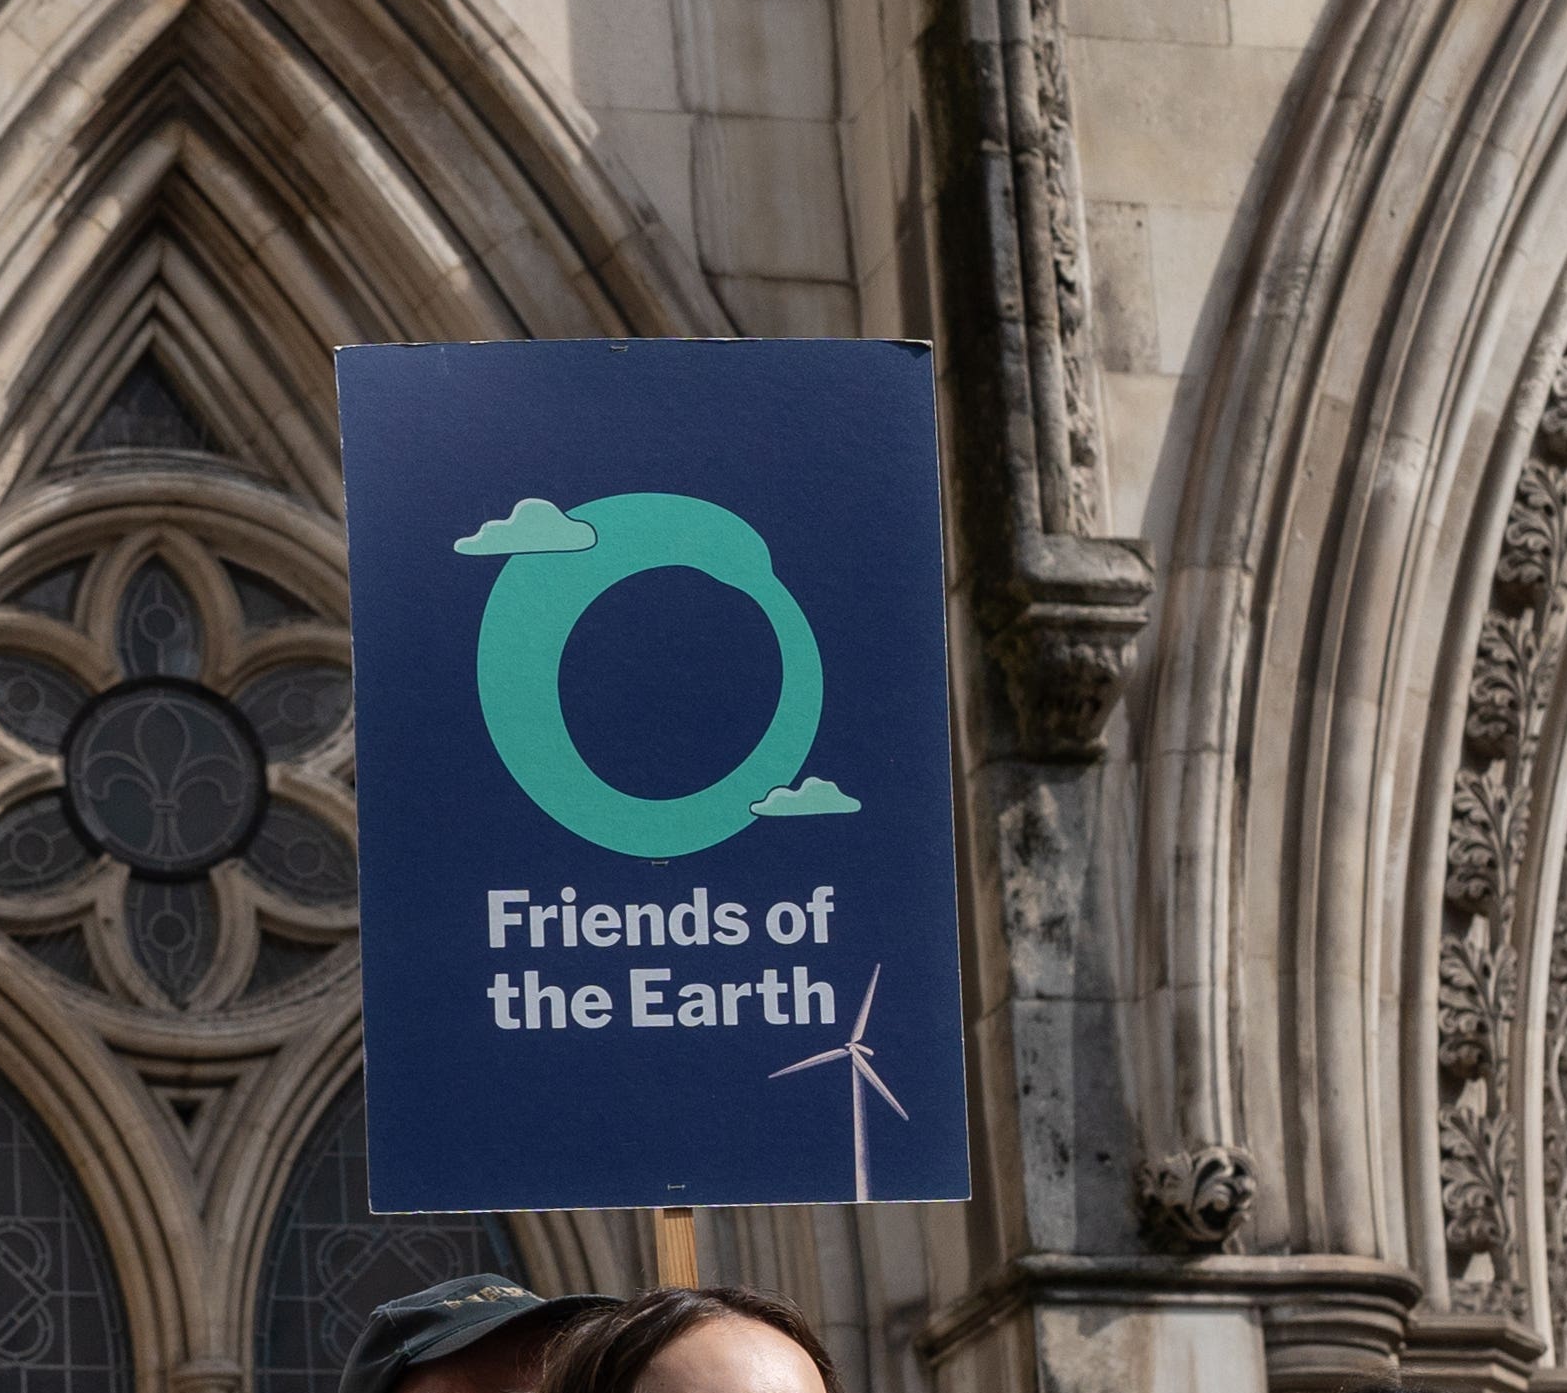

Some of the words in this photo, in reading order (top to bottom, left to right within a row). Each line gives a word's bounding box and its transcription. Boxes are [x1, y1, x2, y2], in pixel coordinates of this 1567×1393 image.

[488, 886, 749, 949] Friends
[764, 884, 835, 945] of
[486, 970, 613, 1031] the
[629, 964, 837, 1029] Earth
